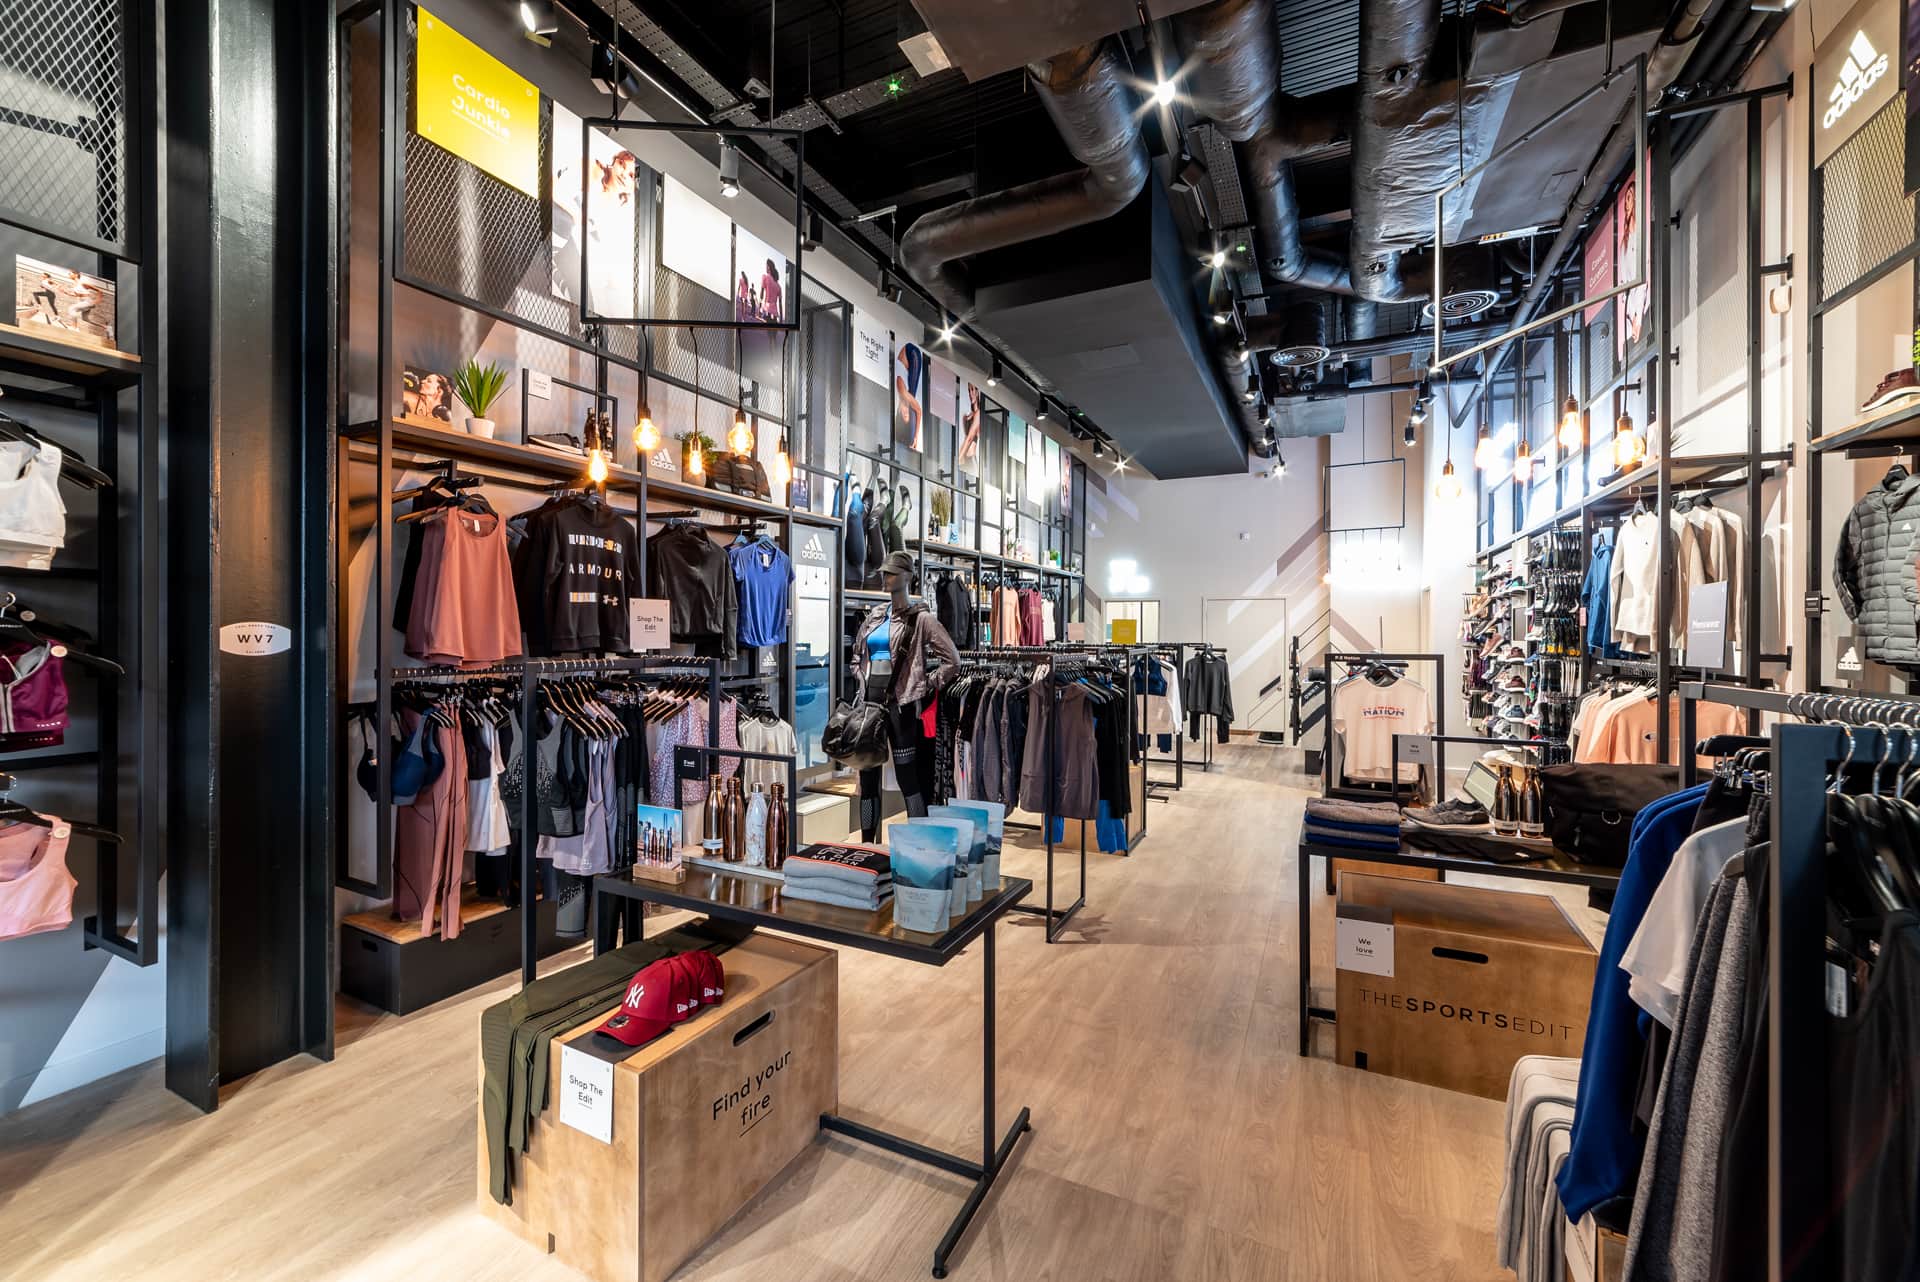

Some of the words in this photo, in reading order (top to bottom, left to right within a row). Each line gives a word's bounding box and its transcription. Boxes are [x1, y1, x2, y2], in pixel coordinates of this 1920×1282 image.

[452, 74, 510, 120] Cardio
[1823, 53, 1888, 129] adidas
[451, 96, 510, 138] Junkie
[860, 331, 870, 342] The
[870, 338, 884, 353] Right
[865, 345, 879, 360] Tight
[650, 459, 677, 472] adidas
[801, 550, 826, 561] adidas
[569, 563, 622, 580] ARMOUR
[1363, 706, 1405, 717] NATION
[1357, 937, 1372, 946] We
[1355, 946, 1373, 955] love
[569, 1074, 588, 1091] Shop
[589, 1082, 603, 1097] The
[712, 1077, 750, 1121] Find
[755, 1051, 791, 1090] your
[578, 1091, 593, 1106] Edit
[740, 1093, 771, 1126] fire
